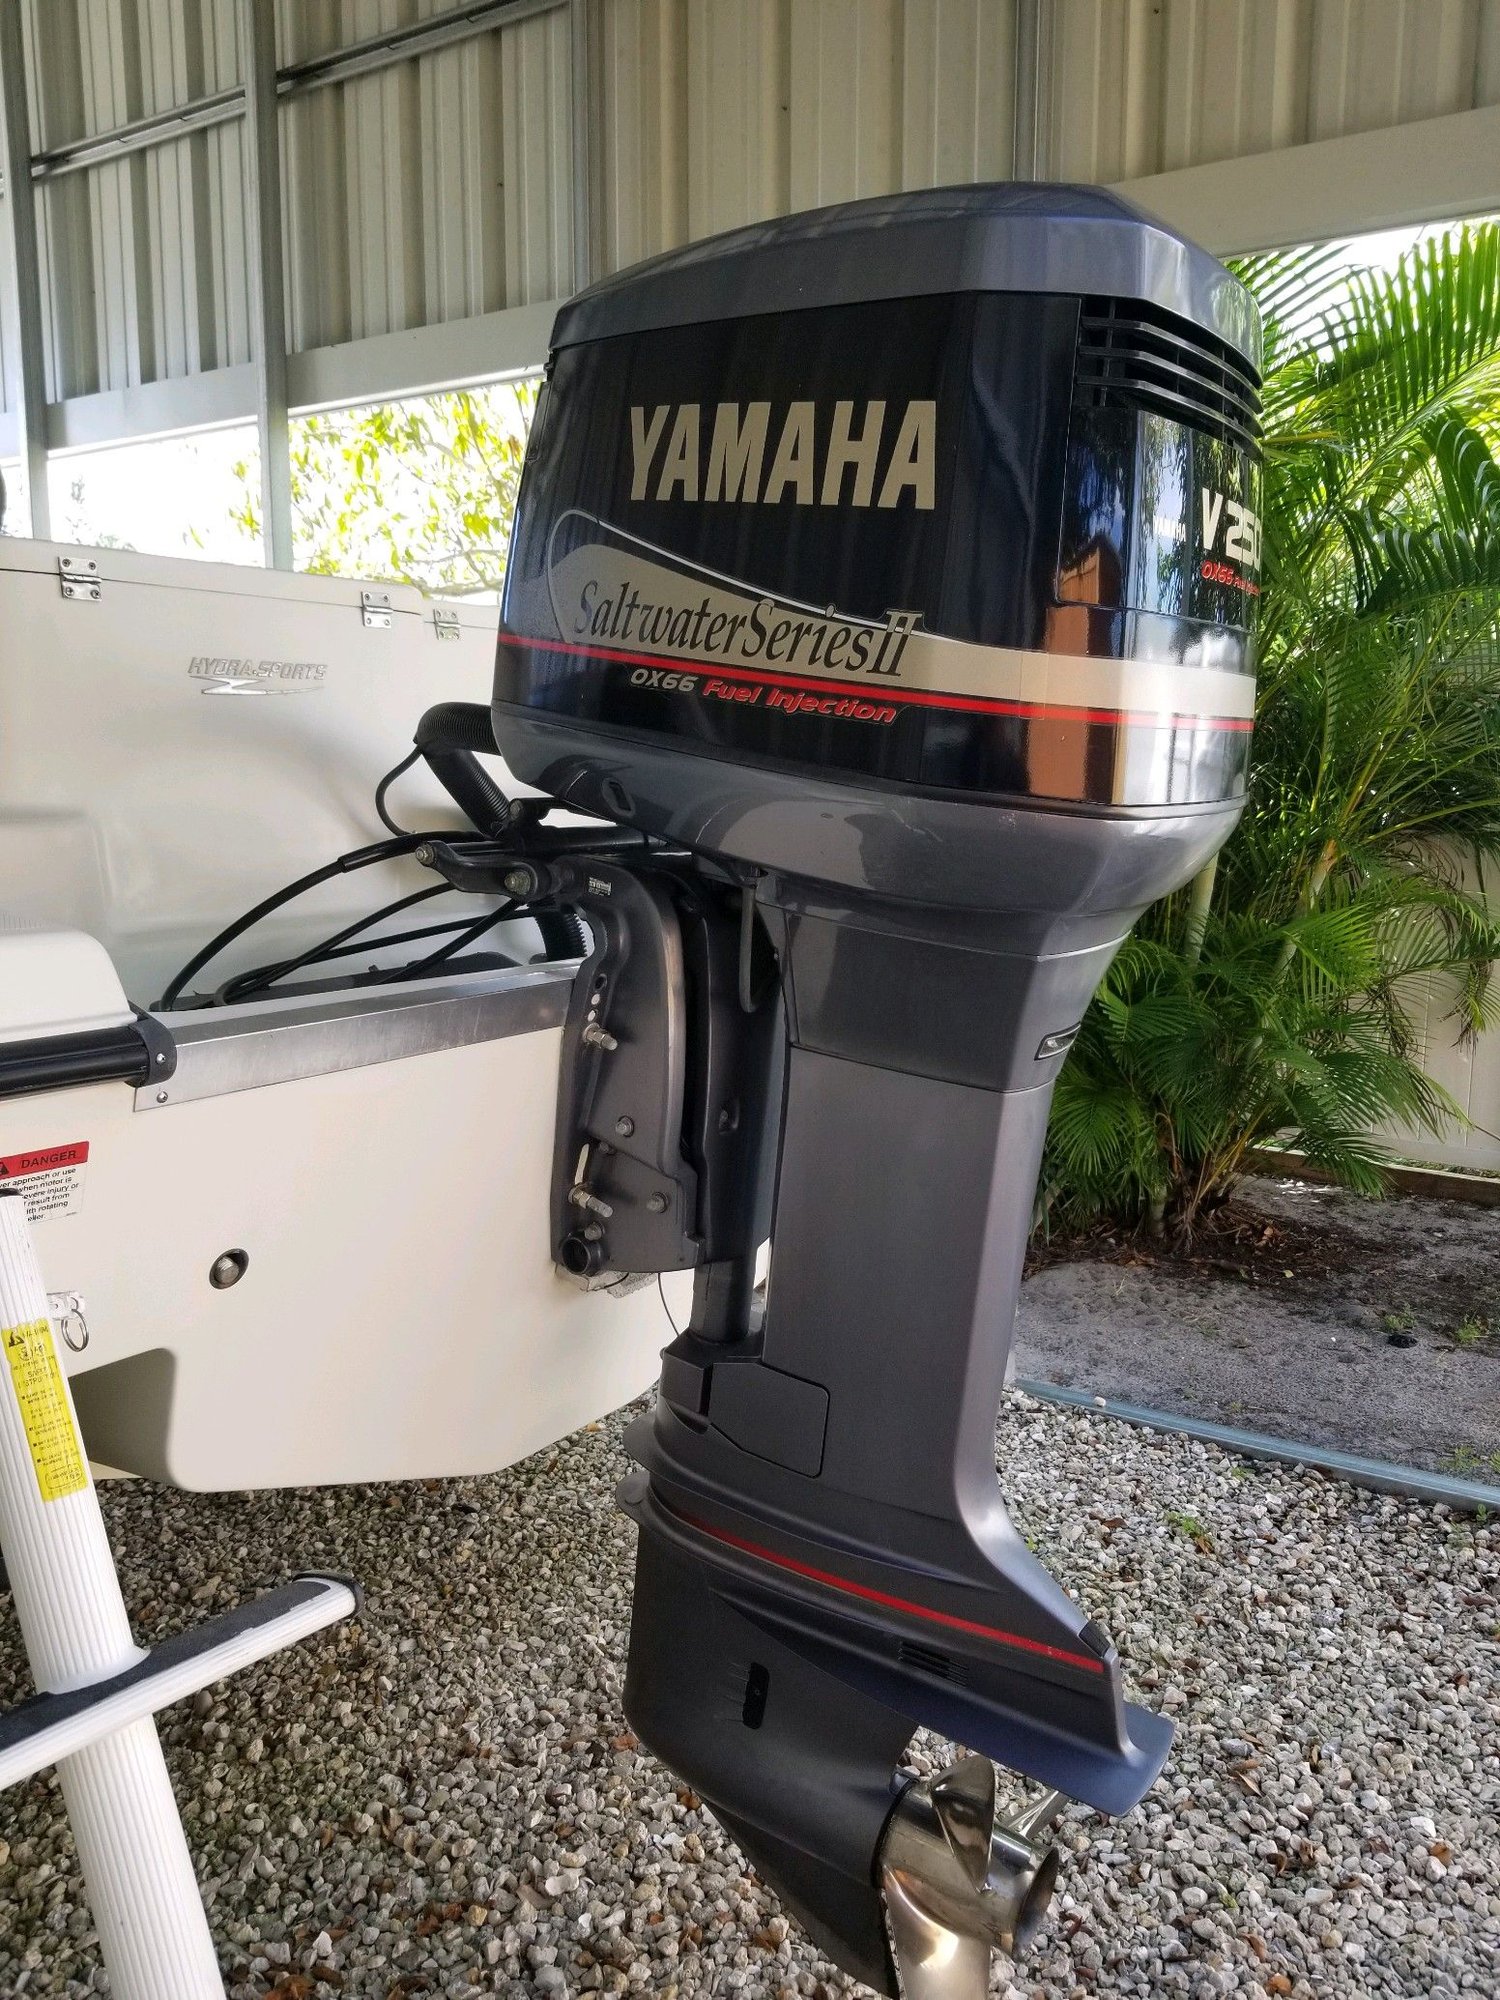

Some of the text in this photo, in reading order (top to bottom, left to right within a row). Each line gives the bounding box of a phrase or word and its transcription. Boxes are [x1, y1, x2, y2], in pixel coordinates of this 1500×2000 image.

[630, 400, 937, 511] YAMAHA
[629, 667, 898, 724] OX66 Fuel Injection
[21, 1150, 77, 1168] DANGER
[12, 1173, 50, 1186] approach
[40, 1178, 64, 1187] motor
[22, 1190, 45, 1200] evere
[47, 1185, 69, 1195] injury
[27, 1195, 51, 1207] result
[51, 1193, 70, 1201] from
[38, 1201, 68, 1212] rotating
